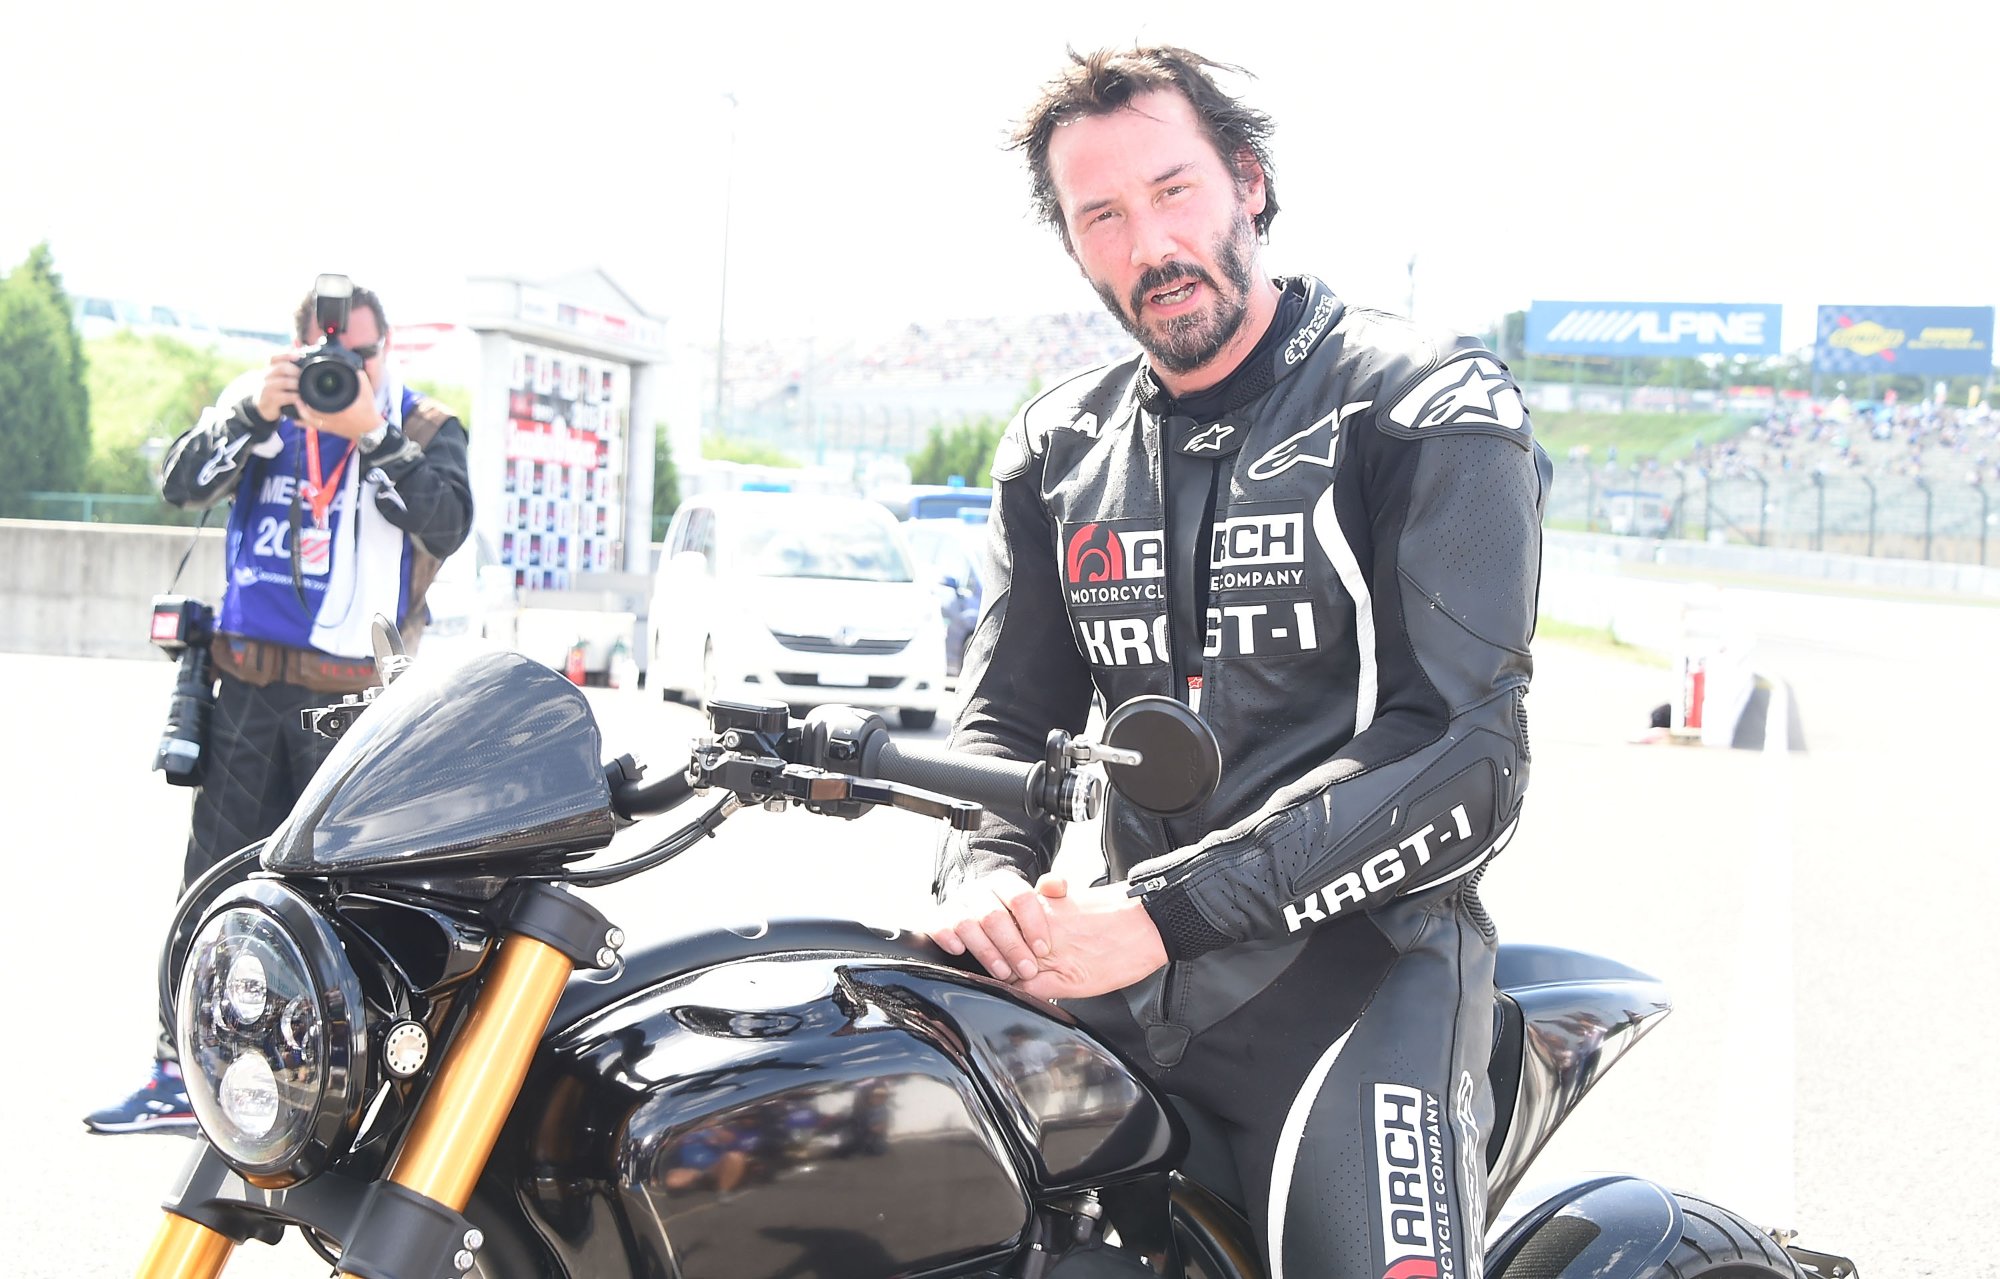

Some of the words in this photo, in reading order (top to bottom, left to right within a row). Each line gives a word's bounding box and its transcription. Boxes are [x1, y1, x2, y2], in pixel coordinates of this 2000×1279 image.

[1611, 309, 1766, 345] ALPINE
[1282, 804, 1473, 933] KRGT-1
[1383, 1093, 1428, 1247] ARCH
[1426, 1093, 1446, 1195] COMPANY
